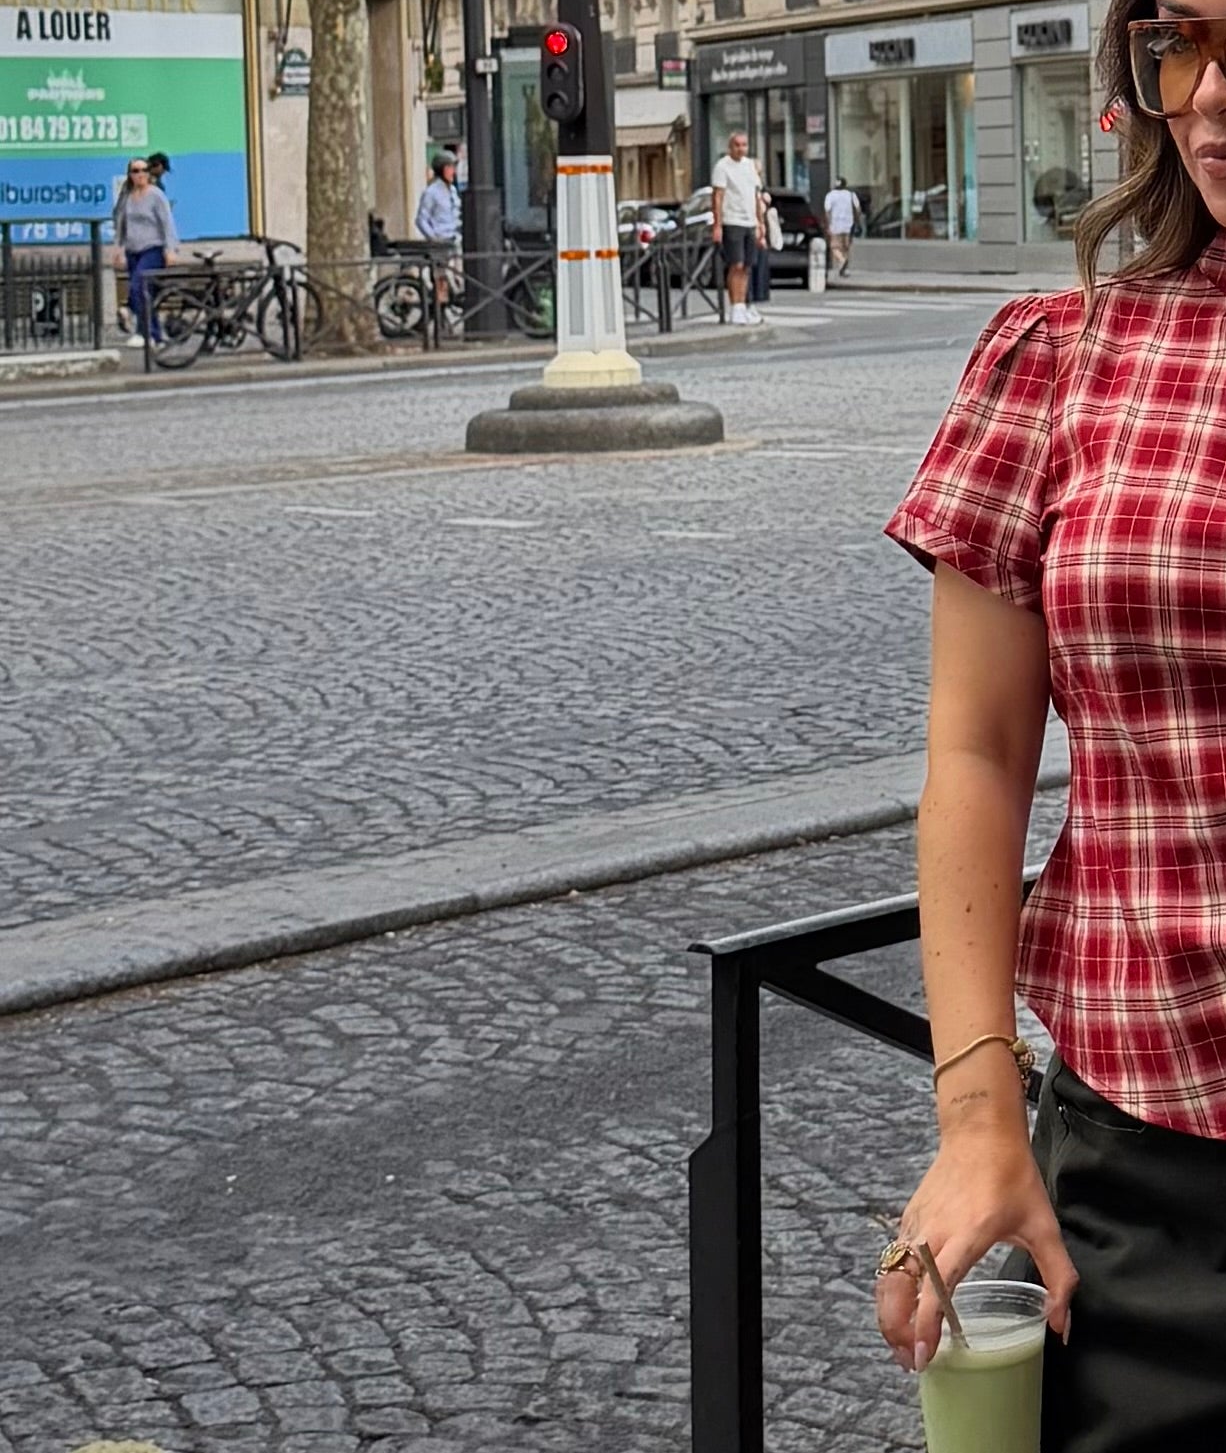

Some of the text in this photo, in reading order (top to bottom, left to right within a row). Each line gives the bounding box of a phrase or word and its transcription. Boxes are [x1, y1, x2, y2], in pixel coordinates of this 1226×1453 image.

[16, 8, 111, 41] A LOUER
[72, 115, 94, 141] 73
[96, 115, 118, 141] 73
